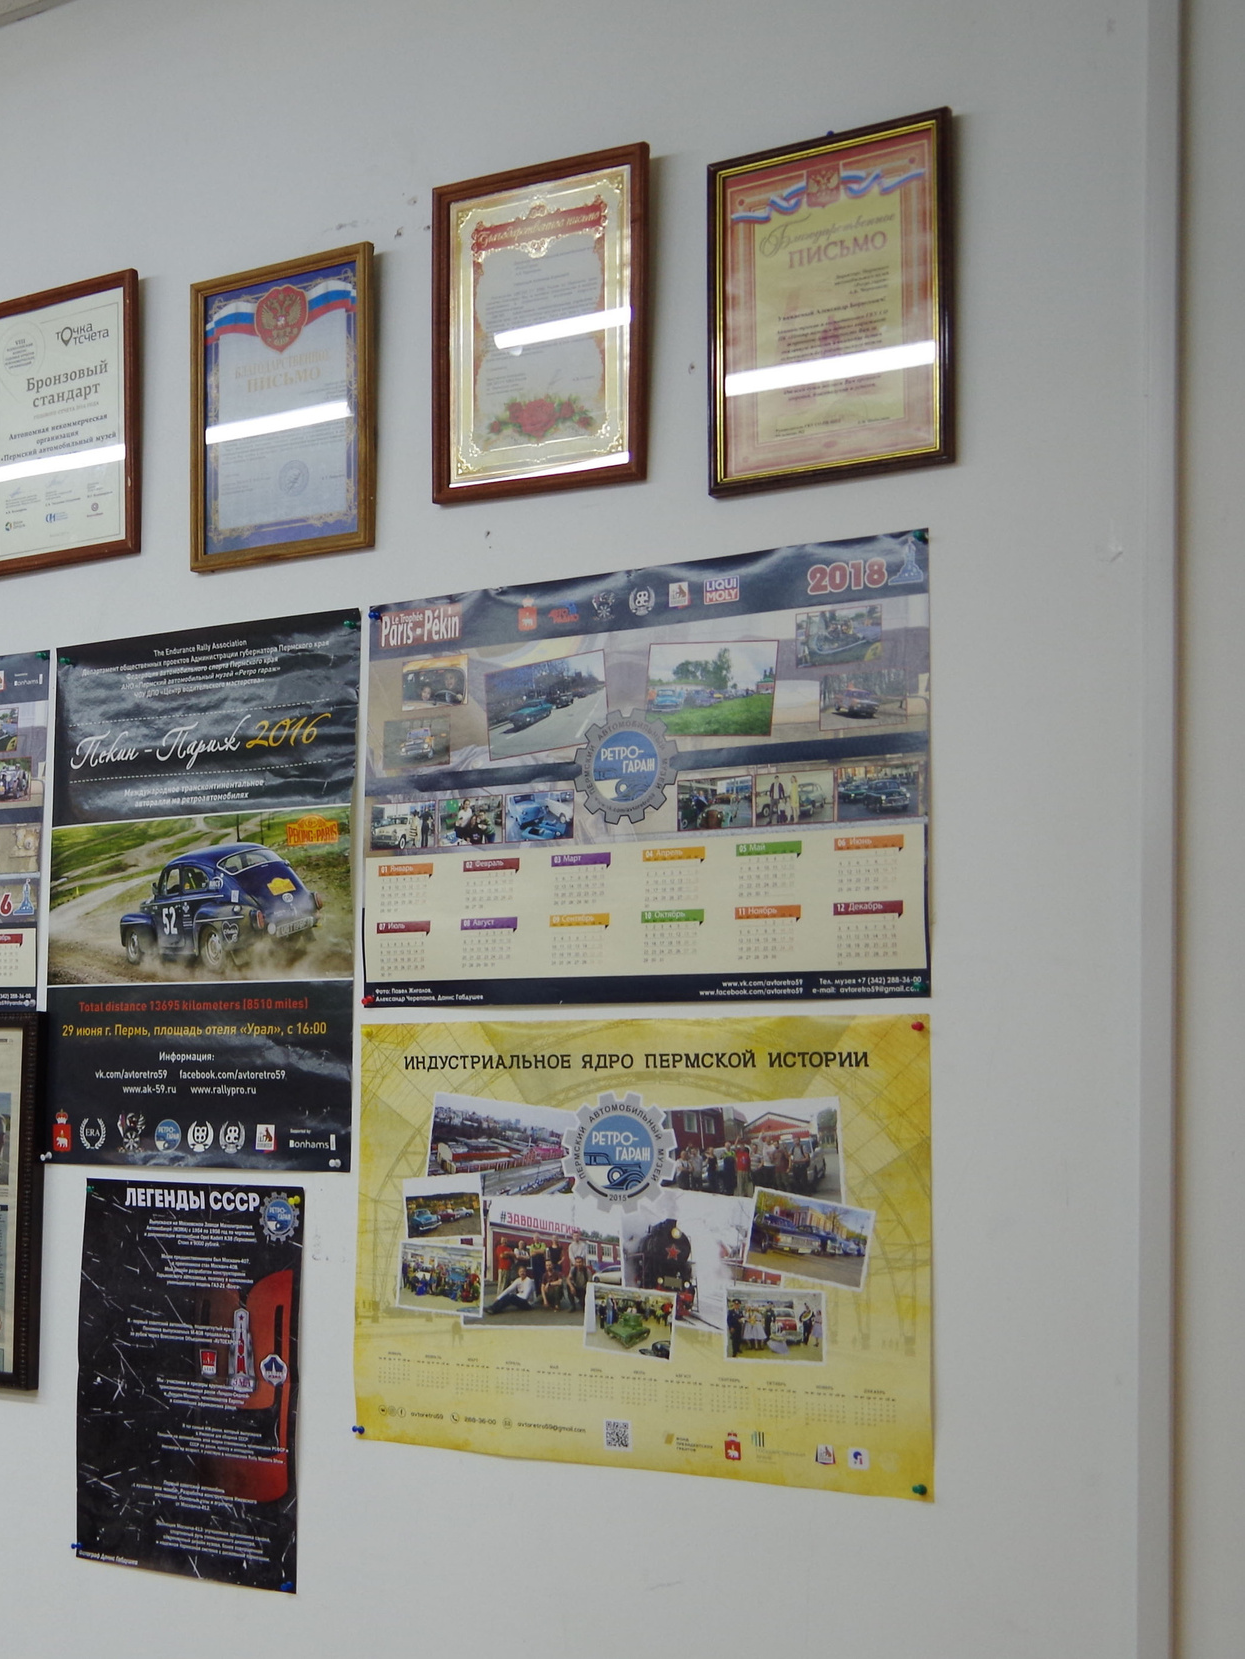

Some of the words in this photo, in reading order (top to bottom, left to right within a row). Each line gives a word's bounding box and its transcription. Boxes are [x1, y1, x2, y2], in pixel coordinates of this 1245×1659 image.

[789, 231, 887, 269] ПИСЬМО
[26, 359, 109, 393] Бронзовый
[247, 366, 321, 394] ПИСЬМО
[33, 382, 100, 408] стандарт
[9, 427, 49, 441] Автономная
[51, 414, 107, 432] некоммерческая
[37, 431, 79, 445] организация
[808, 558, 887, 595] 2018
[706, 578, 737, 591] LIQUI
[706, 589, 738, 603] MOLY
[381, 616, 414, 647] Paris
[424, 607, 459, 641] Pékin
[166, 646, 195, 655] Endurance
[197, 643, 211, 651] Rally
[212, 639, 247, 650] Association
[70, 730, 139, 770] Пекин
[156, 714, 252, 770] Париж
[245, 713, 331, 749] 2016
[601, 746, 644, 761] РЕТРО-
[623, 758, 655, 773] ГАРАЖ
[739, 845, 747, 853] 05
[749, 843, 766, 852] Май
[475, 859, 504, 868] Февраль
[554, 856, 561, 864] 03
[563, 854, 582, 863] Март
[380, 866, 387, 874] 01
[389, 864, 414, 873] Январь
[738, 908, 745, 916] 11
[748, 906, 777, 916] Ноябрь
[837, 904, 844, 912] 12
[849, 902, 883, 912] Декабрь
[162, 906, 177, 936] 52
[379, 923, 386, 931] 07
[388, 922, 405, 931] Июль
[464, 919, 470, 927] 08
[472, 918, 494, 927] Август
[79, 1002, 103, 1012] Total
[106, 1002, 147, 1011] distance
[149, 1001, 179, 1011] 13695
[182, 1000, 240, 1010] kilometers
[243, 999, 271, 1010] (8510
[275, 998, 308, 1009] miles)
[62, 1025, 74, 1037] 29
[77, 1027, 102, 1036] июня
[106, 1027, 111, 1036] г.
[115, 1024, 150, 1038] Пермь,
[154, 1026, 202, 1038] площадь
[205, 1025, 236, 1035] отеля
[240, 1023, 283, 1036] «Урал»,
[287, 1026, 293, 1034] с
[297, 1022, 327, 1034] 16:00
[159, 1051, 215, 1063] Информация:
[405, 1055, 571, 1070] ИНДУСТРИАЛЬНОЕ
[581, 1054, 633, 1071] ЯДРО
[645, 1050, 756, 1069] ПЕРМСКОЙ
[769, 1051, 869, 1068] ИСТОРИИ
[95, 1069, 167, 1079] vk.com/avtoretro59
[179, 1069, 286, 1080] facebook.com/avtoretro59
[122, 1085, 176, 1094] www.ak-59.ru
[191, 1085, 256, 1096] www.rallypro.ru
[86, 1128, 100, 1136] ERA
[592, 1131, 638, 1145] РЕТРО-
[289, 1139, 330, 1149] Bonhams
[573, 1126, 586, 1179] ПЕРМСКИЙ
[589, 1104, 662, 1140] АВТОМОБИЛЬНЫЙ
[653, 1149, 664, 1182] МУЗЕЙ
[616, 1147, 650, 1161] ГАРАЖ
[125, 1188, 205, 1210] ЛЕГЕНДЫ
[209, 1191, 260, 1212] СССР
[464, 1417, 496, 1425] 288-36-00
[517, 1422, 586, 1433] avtoretro59@gmail.com
